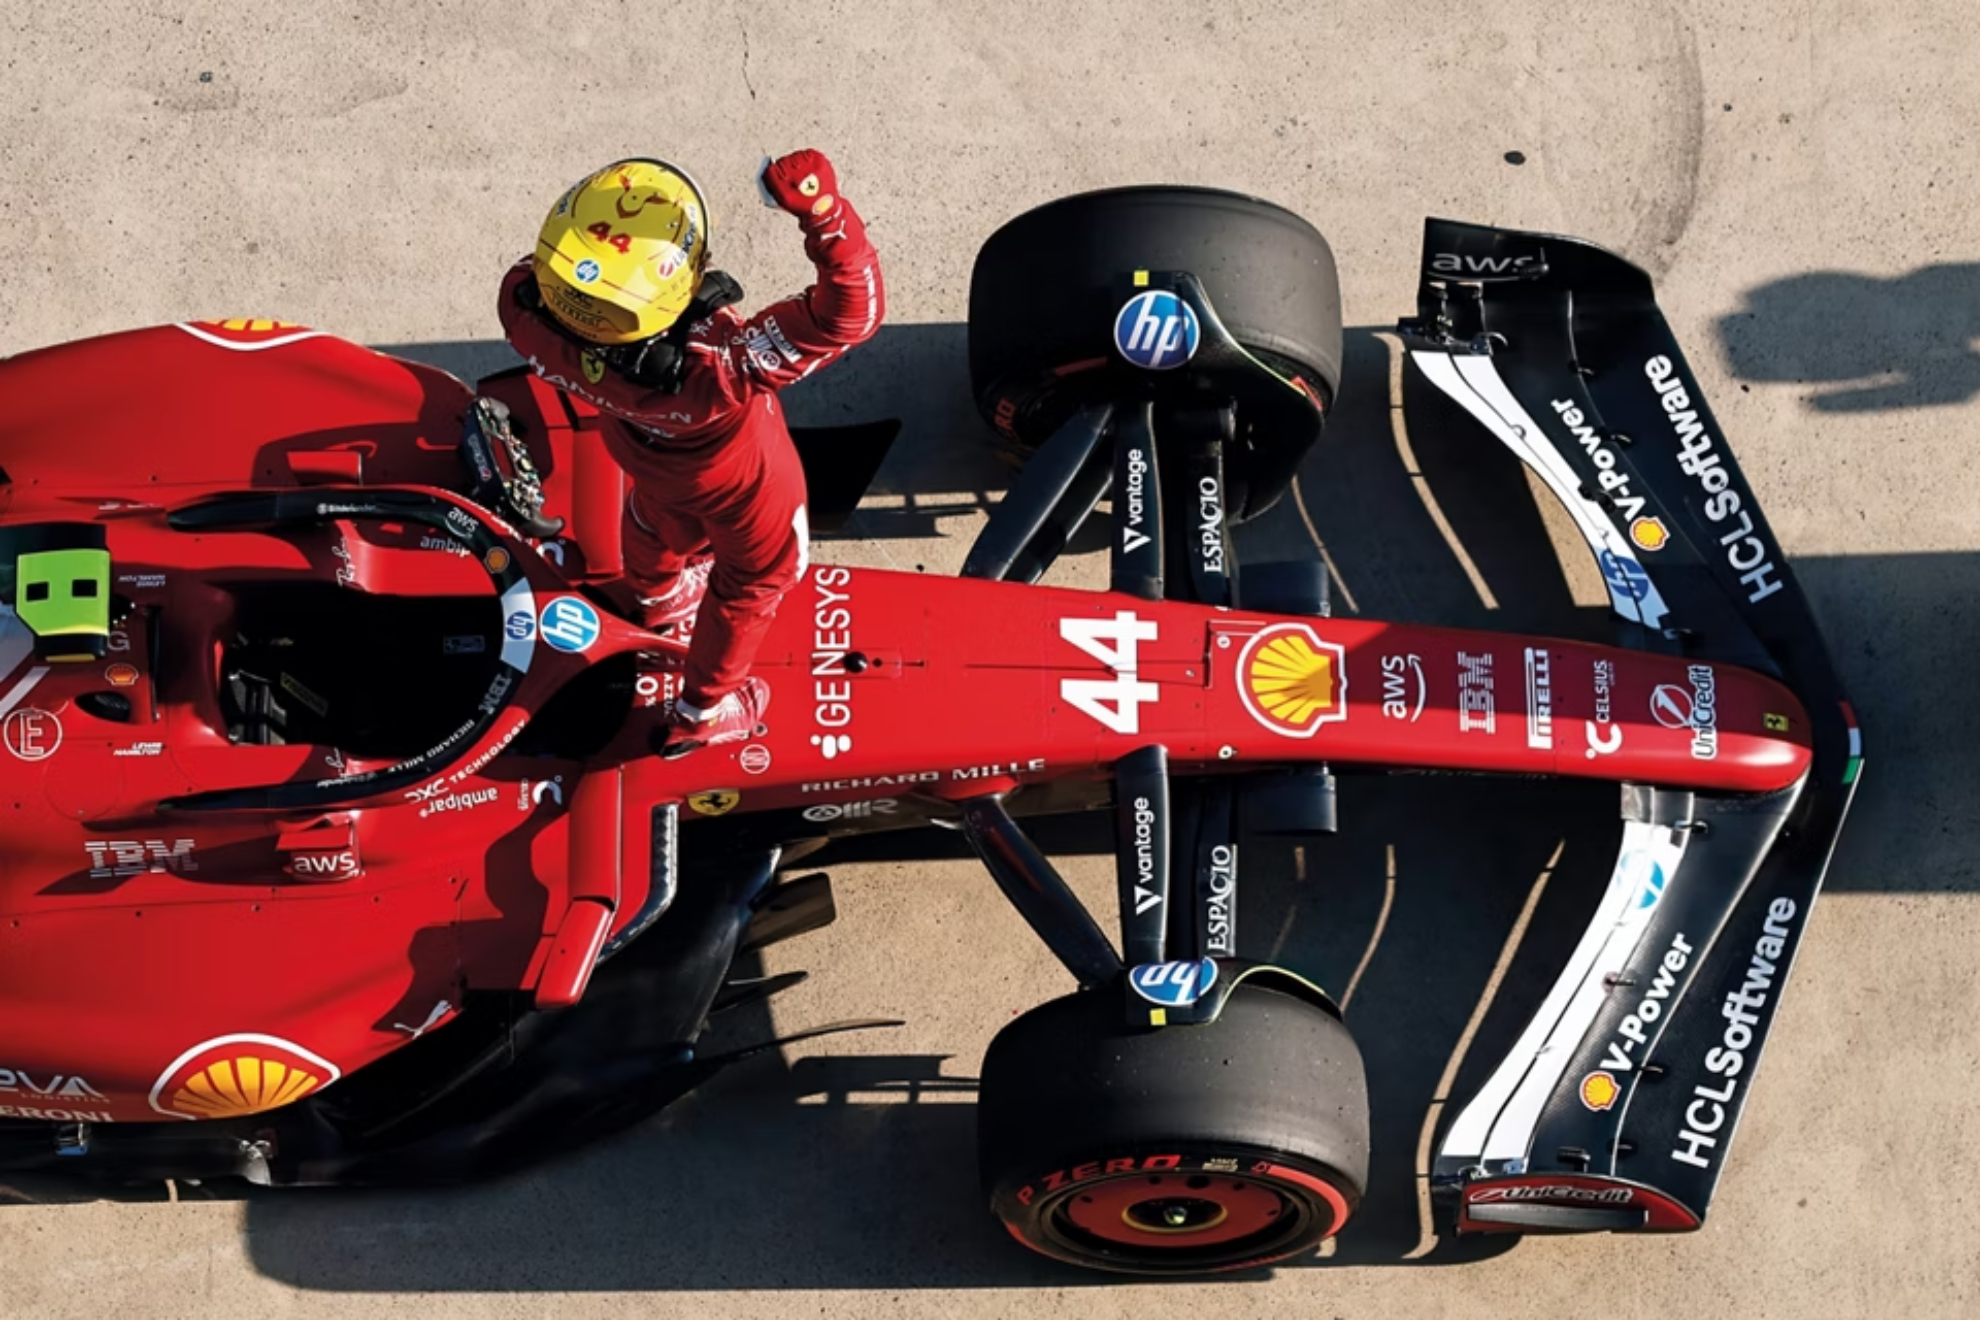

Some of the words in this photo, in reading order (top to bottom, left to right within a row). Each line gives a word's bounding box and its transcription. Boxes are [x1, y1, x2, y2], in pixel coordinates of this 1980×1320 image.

[1431, 252, 1537, 273] aws
[1126, 291, 1191, 368] hp
[1126, 449, 1149, 527] vantage
[1551, 398, 1645, 522] V-Power
[1644, 355, 1783, 603] HCLSoftware
[447, 507, 481, 533] aws
[1201, 476, 1223, 573] ESPACIO
[543, 601, 600, 646] hp
[811, 567, 851, 728] GENESYS
[1060, 611, 1159, 734] 44
[1382, 654, 1406, 719] aws
[1457, 650, 1496, 734] IBM
[1525, 647, 1553, 750] PIRELLI
[1593, 659, 1609, 723] CELSIUS
[1687, 664, 1718, 760] UniCredit
[449, 718, 526, 785] TECHNOLOGY
[802, 770, 940, 793] RICHARD
[951, 758, 1046, 780] MILLE
[428, 787, 498, 812] ambipar
[85, 838, 199, 878] IBM
[294, 851, 357, 873] aws
[1135, 797, 1154, 884] vantage
[1208, 844, 1231, 951] ESPACIO
[1599, 932, 1693, 1072] V-Power
[1671, 896, 1797, 1168] HCLSoftware
[1016, 1183, 1034, 1206] P
[1042, 1154, 1182, 1193] ZERO
[1502, 1186, 1635, 1204] UniCredit
